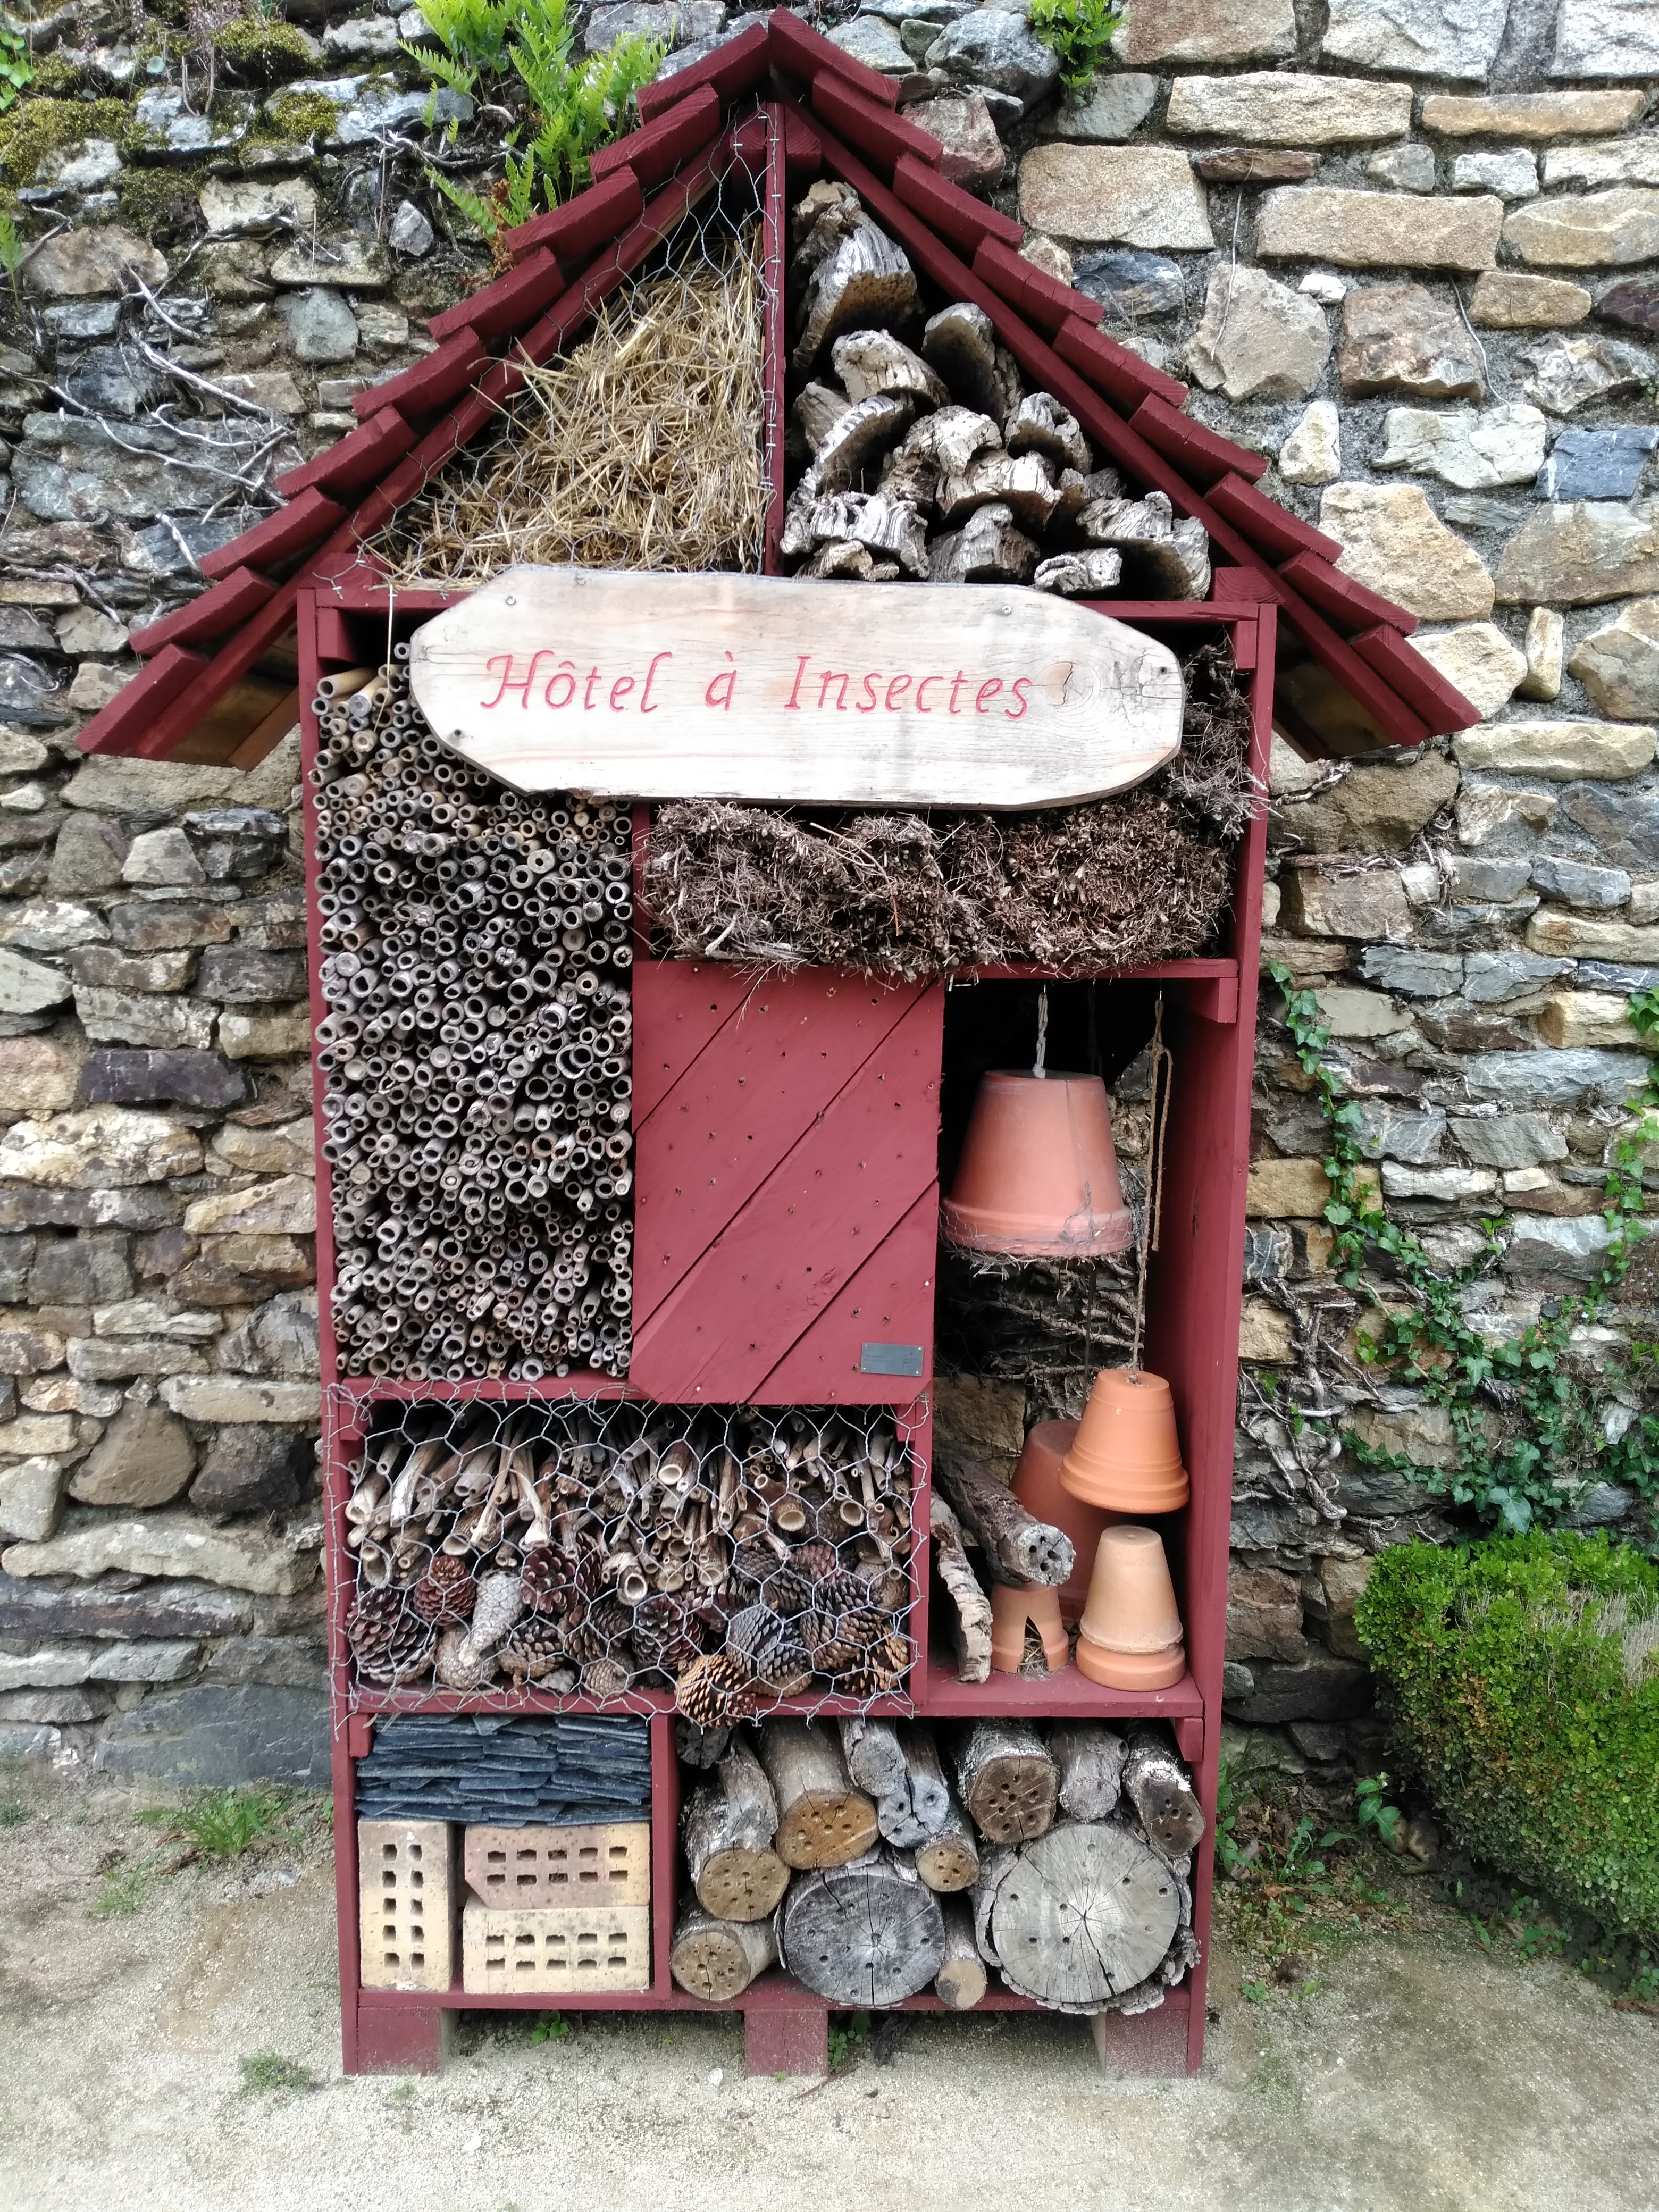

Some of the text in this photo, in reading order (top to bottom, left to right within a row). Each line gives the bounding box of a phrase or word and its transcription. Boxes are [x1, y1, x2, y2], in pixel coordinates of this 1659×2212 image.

[480, 649, 1032, 719] Hôtel à Insectes
